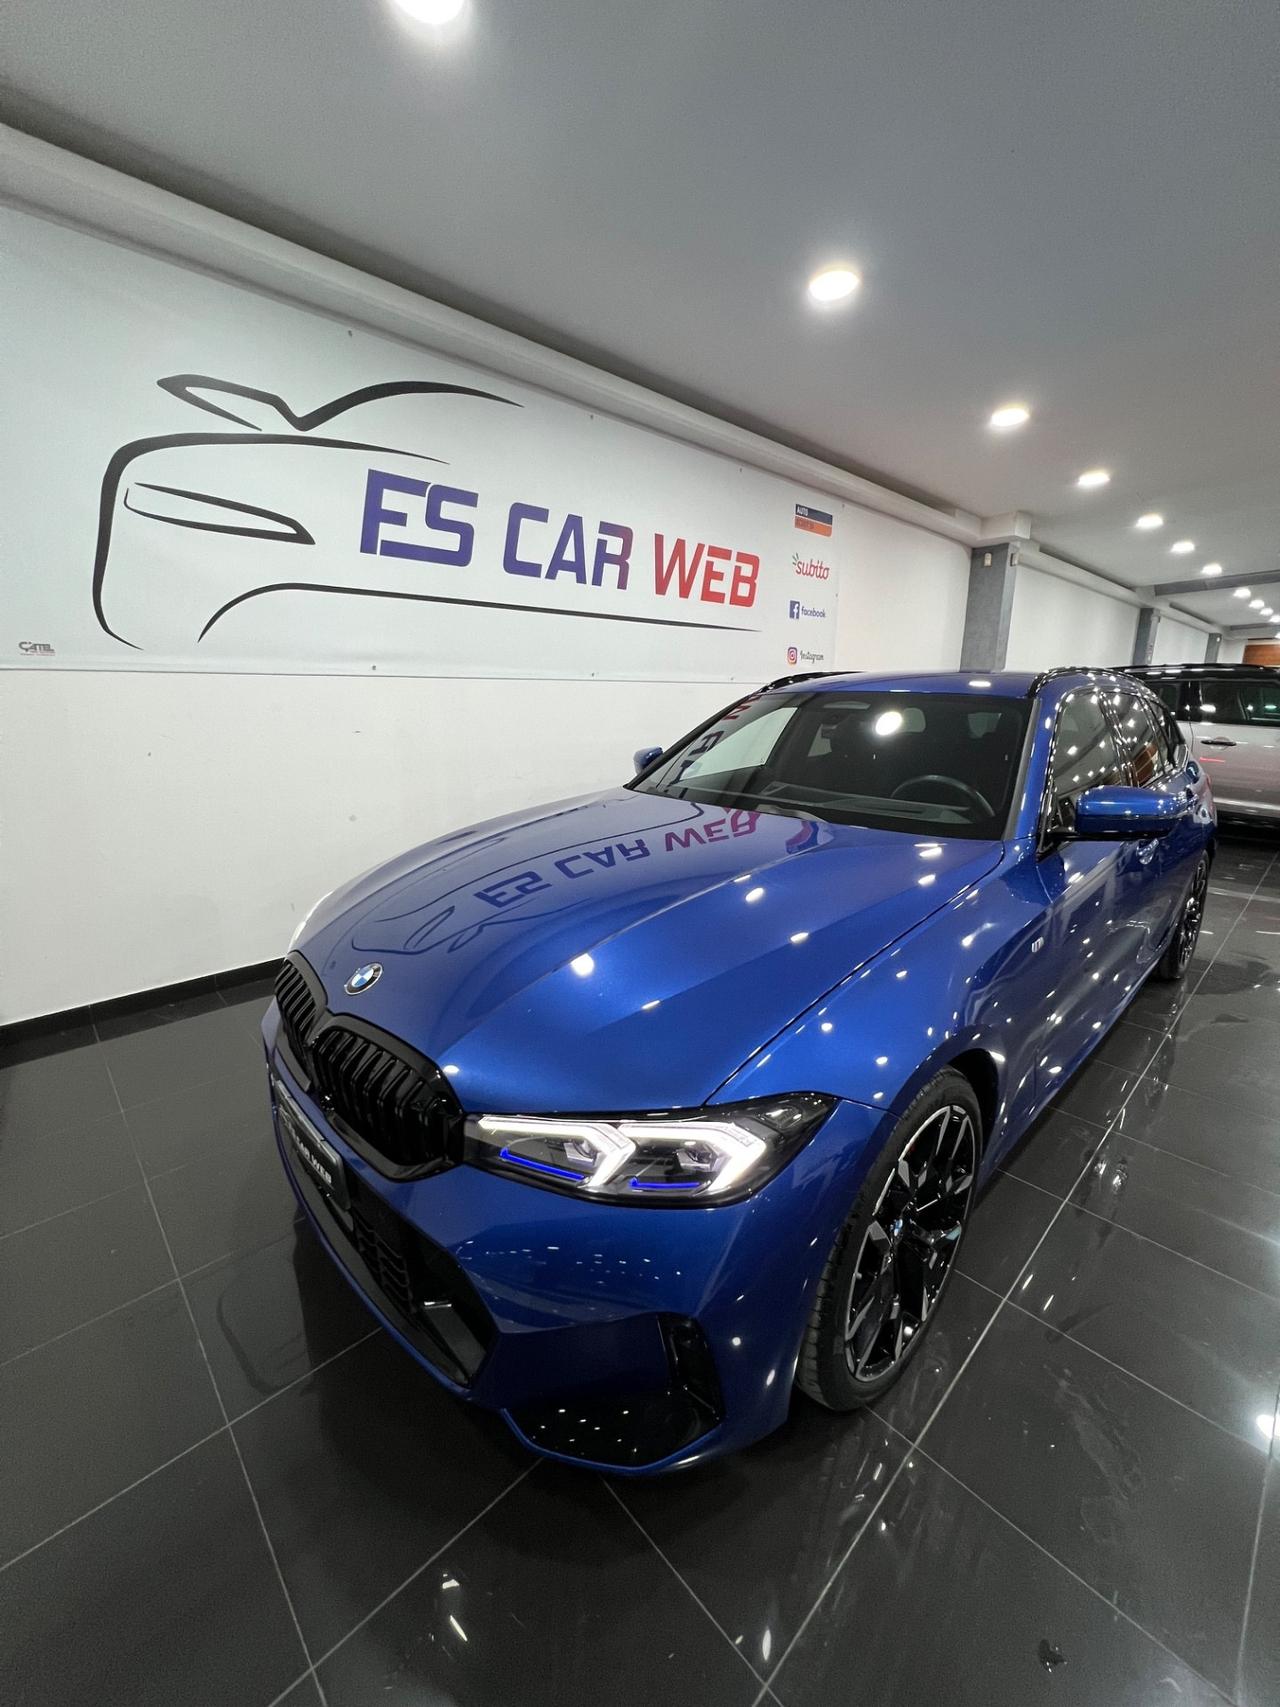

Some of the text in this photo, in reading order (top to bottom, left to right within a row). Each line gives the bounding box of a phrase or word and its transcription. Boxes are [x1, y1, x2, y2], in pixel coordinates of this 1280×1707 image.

[360, 469, 760, 608] ES CAR WEB
[796, 558, 830, 580] subito
[801, 605, 825, 618] facebook
[800, 650, 824, 663] Instagram
